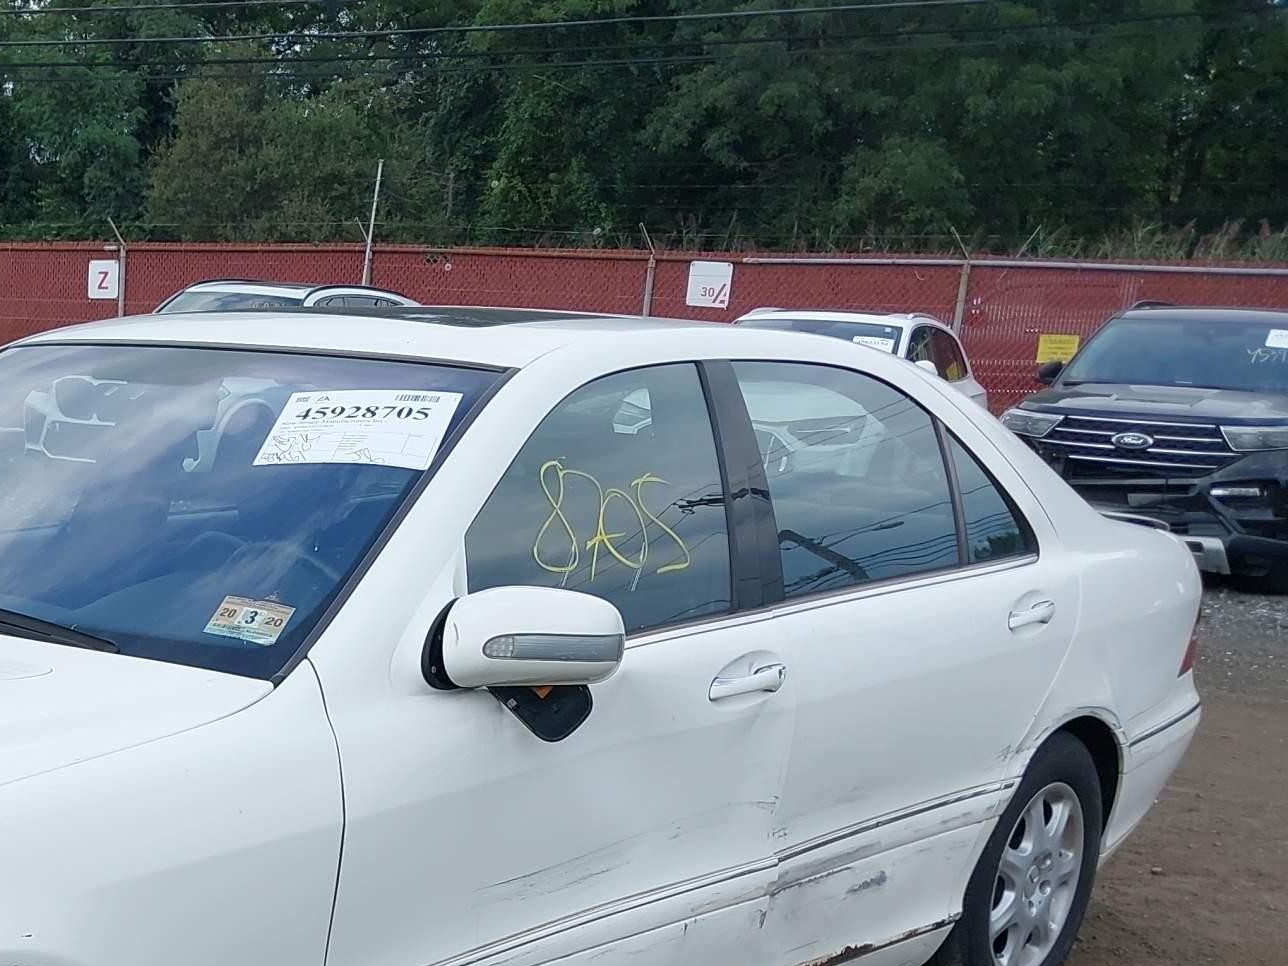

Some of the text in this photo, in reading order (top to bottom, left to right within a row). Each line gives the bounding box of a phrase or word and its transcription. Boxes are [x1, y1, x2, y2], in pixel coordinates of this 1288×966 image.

[97, 271, 109, 290] Z
[295, 405, 433, 420] 45928705
[220, 607, 283, 628] 20 3 20
